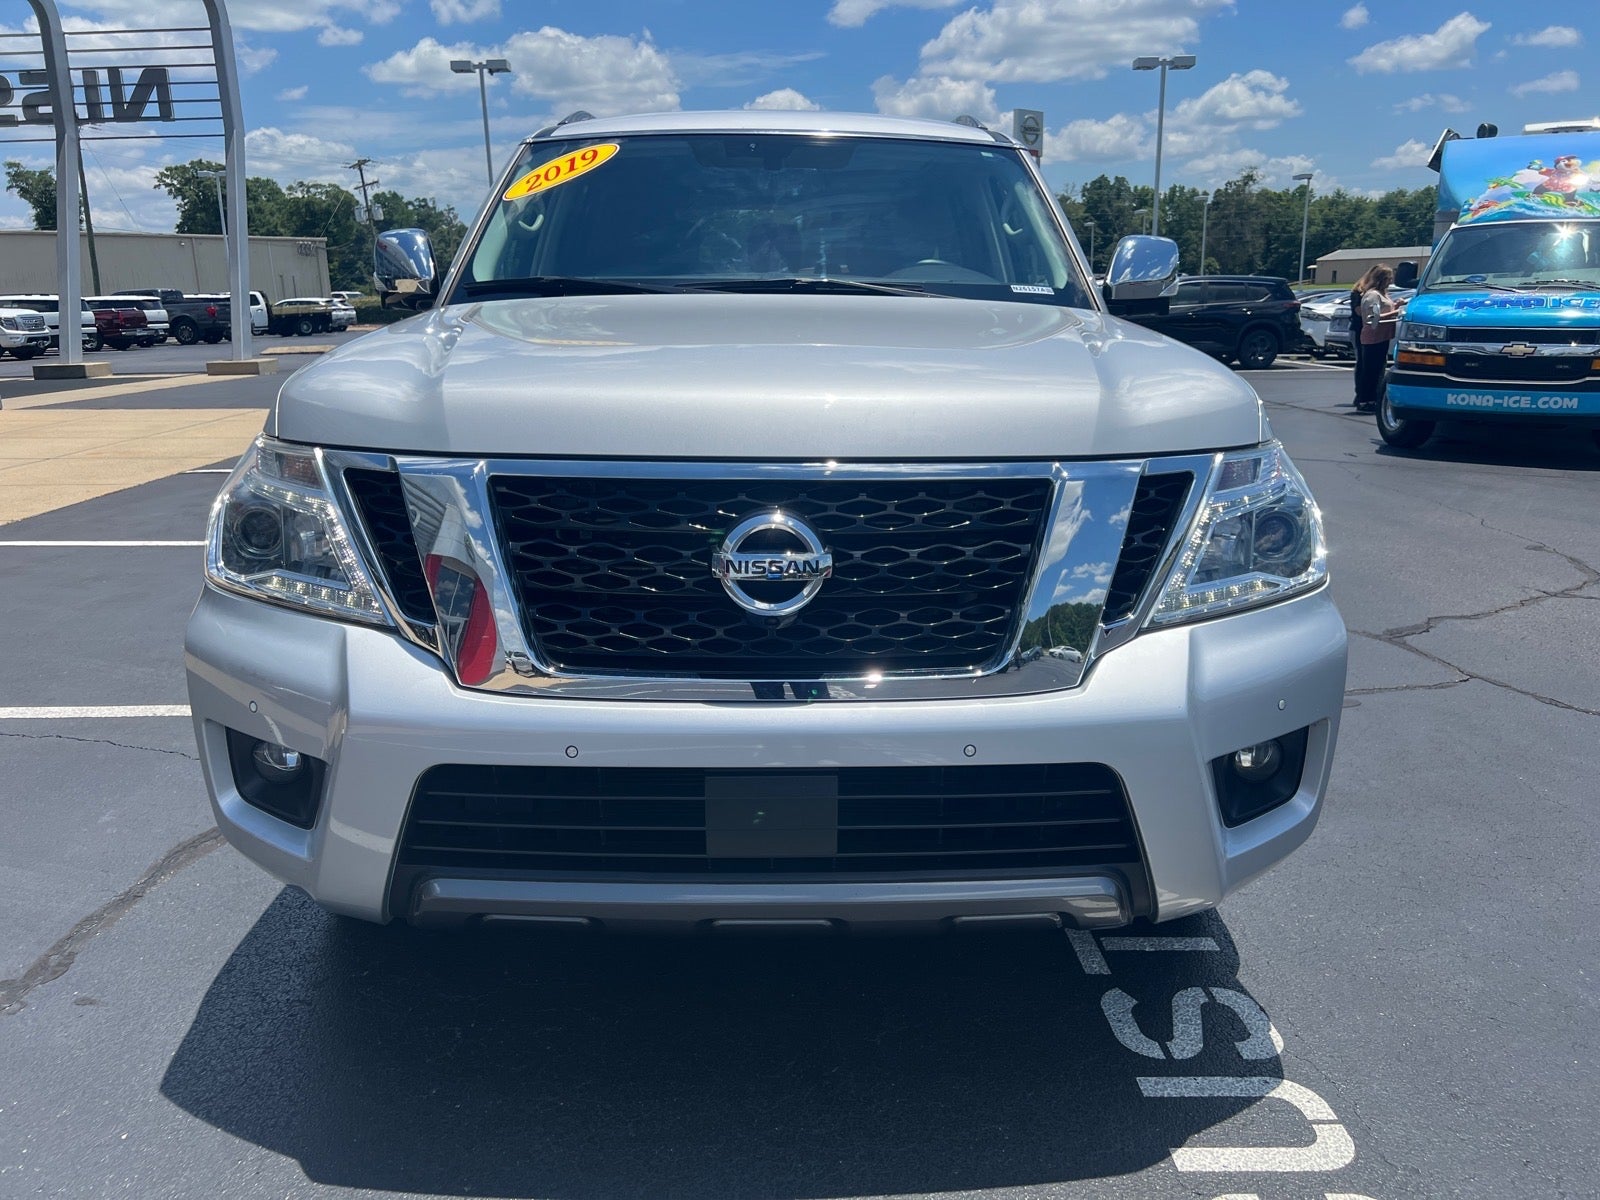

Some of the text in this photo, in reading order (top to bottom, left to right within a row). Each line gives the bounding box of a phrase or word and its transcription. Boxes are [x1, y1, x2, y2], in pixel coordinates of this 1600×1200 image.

[526, 149, 598, 193] 2019
[1453, 297, 1600, 310] KONA ICE
[1447, 393, 1578, 409] KONA-ICE.COM
[725, 559, 819, 575] NISSAN
